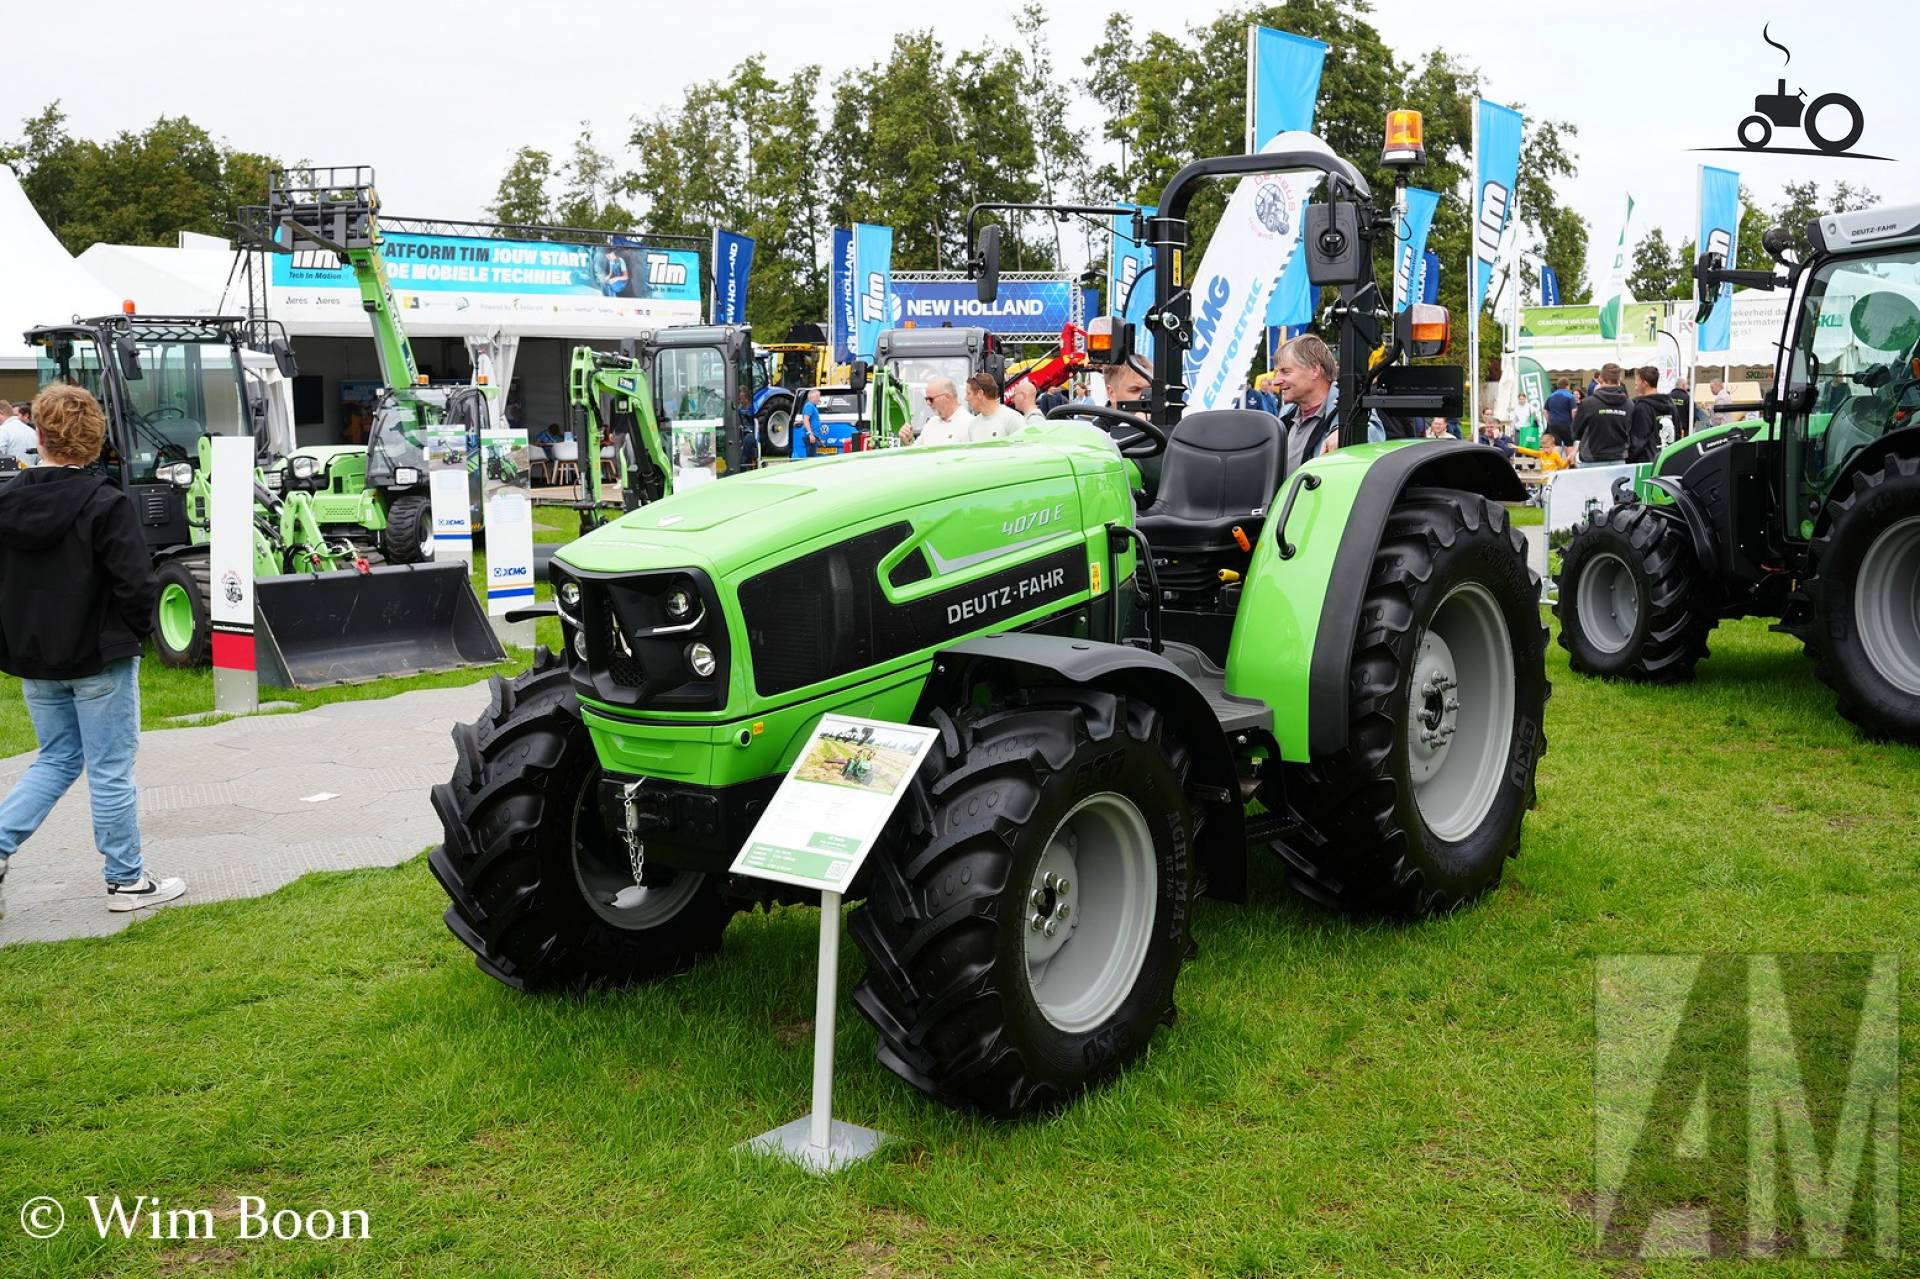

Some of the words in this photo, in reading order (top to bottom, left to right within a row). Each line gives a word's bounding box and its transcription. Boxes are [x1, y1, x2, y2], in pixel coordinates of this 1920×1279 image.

[1851, 224, 1897, 236] DEUTZ-FAHR
[382, 242, 456, 261] ATFORM
[459, 246, 490, 262] TIM
[491, 248, 538, 265] JOUW
[540, 251, 589, 268] START
[647, 252, 688, 286] Tim
[289, 271, 305, 279] Tech
[314, 272, 342, 280] Motion
[386, 262, 411, 279] DE
[411, 263, 489, 283] MOBIELE
[490, 267, 573, 286] TECHNIEK
[845, 240, 855, 302] HOLLAND
[862, 272, 886, 324] Tim
[907, 299, 951, 316] NEW
[953, 299, 1044, 316] HOLLAND
[1731, 307, 1773, 316] ekerheid
[846, 303, 856, 331] NEW
[1182, 274, 1231, 394] XCMG
[1203, 277, 1263, 409] Eurotrac
[1002, 508, 1051, 537] 4070
[1055, 503, 1064, 522] E
[503, 566, 527, 577] XCMG
[946, 568, 1065, 625] DEUTZ-FAHR
